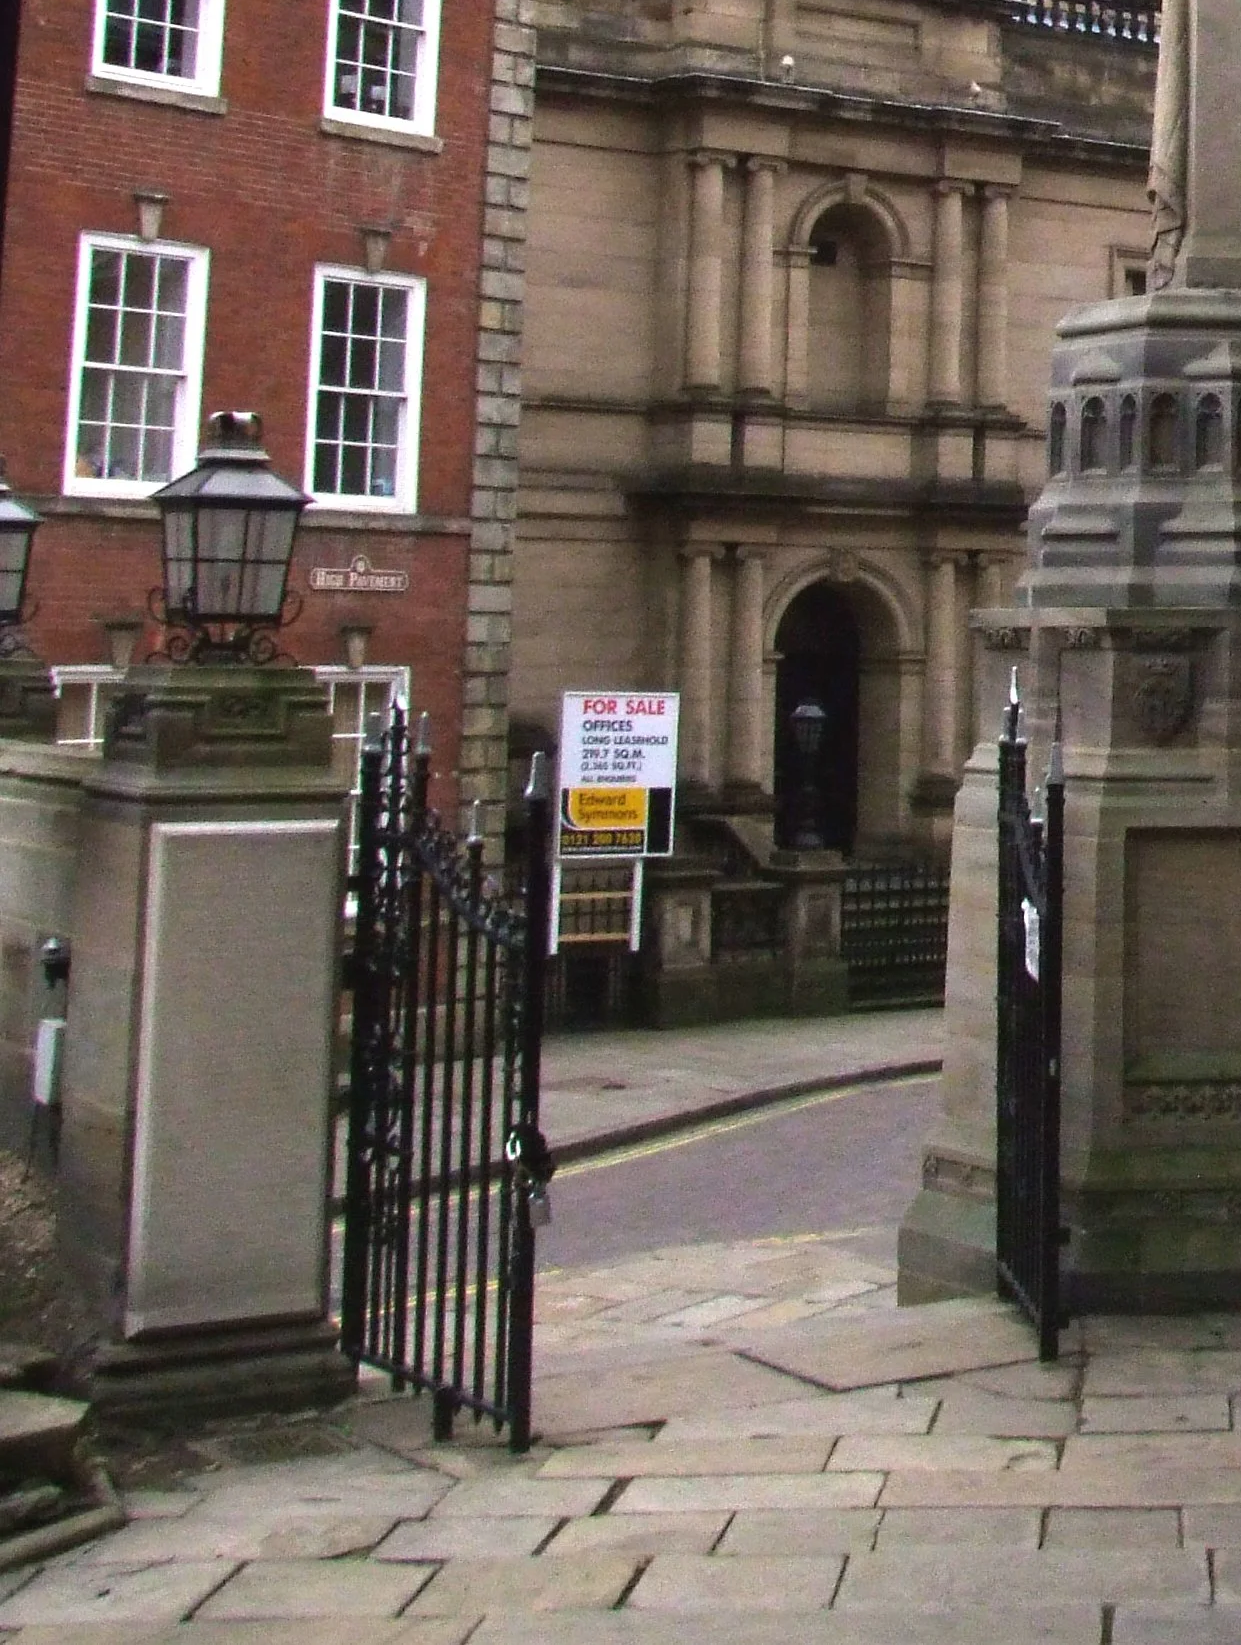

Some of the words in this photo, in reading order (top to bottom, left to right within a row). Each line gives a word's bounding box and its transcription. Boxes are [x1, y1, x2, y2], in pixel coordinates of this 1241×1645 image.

[583, 700, 618, 715] FOR
[626, 700, 665, 715] SALE
[582, 720, 633, 732] OFFICES
[582, 736, 611, 745] LONG
[614, 736, 669, 745] LEASEHOLD
[579, 793, 627, 806] Edward
[578, 809, 638, 823] Symmons
